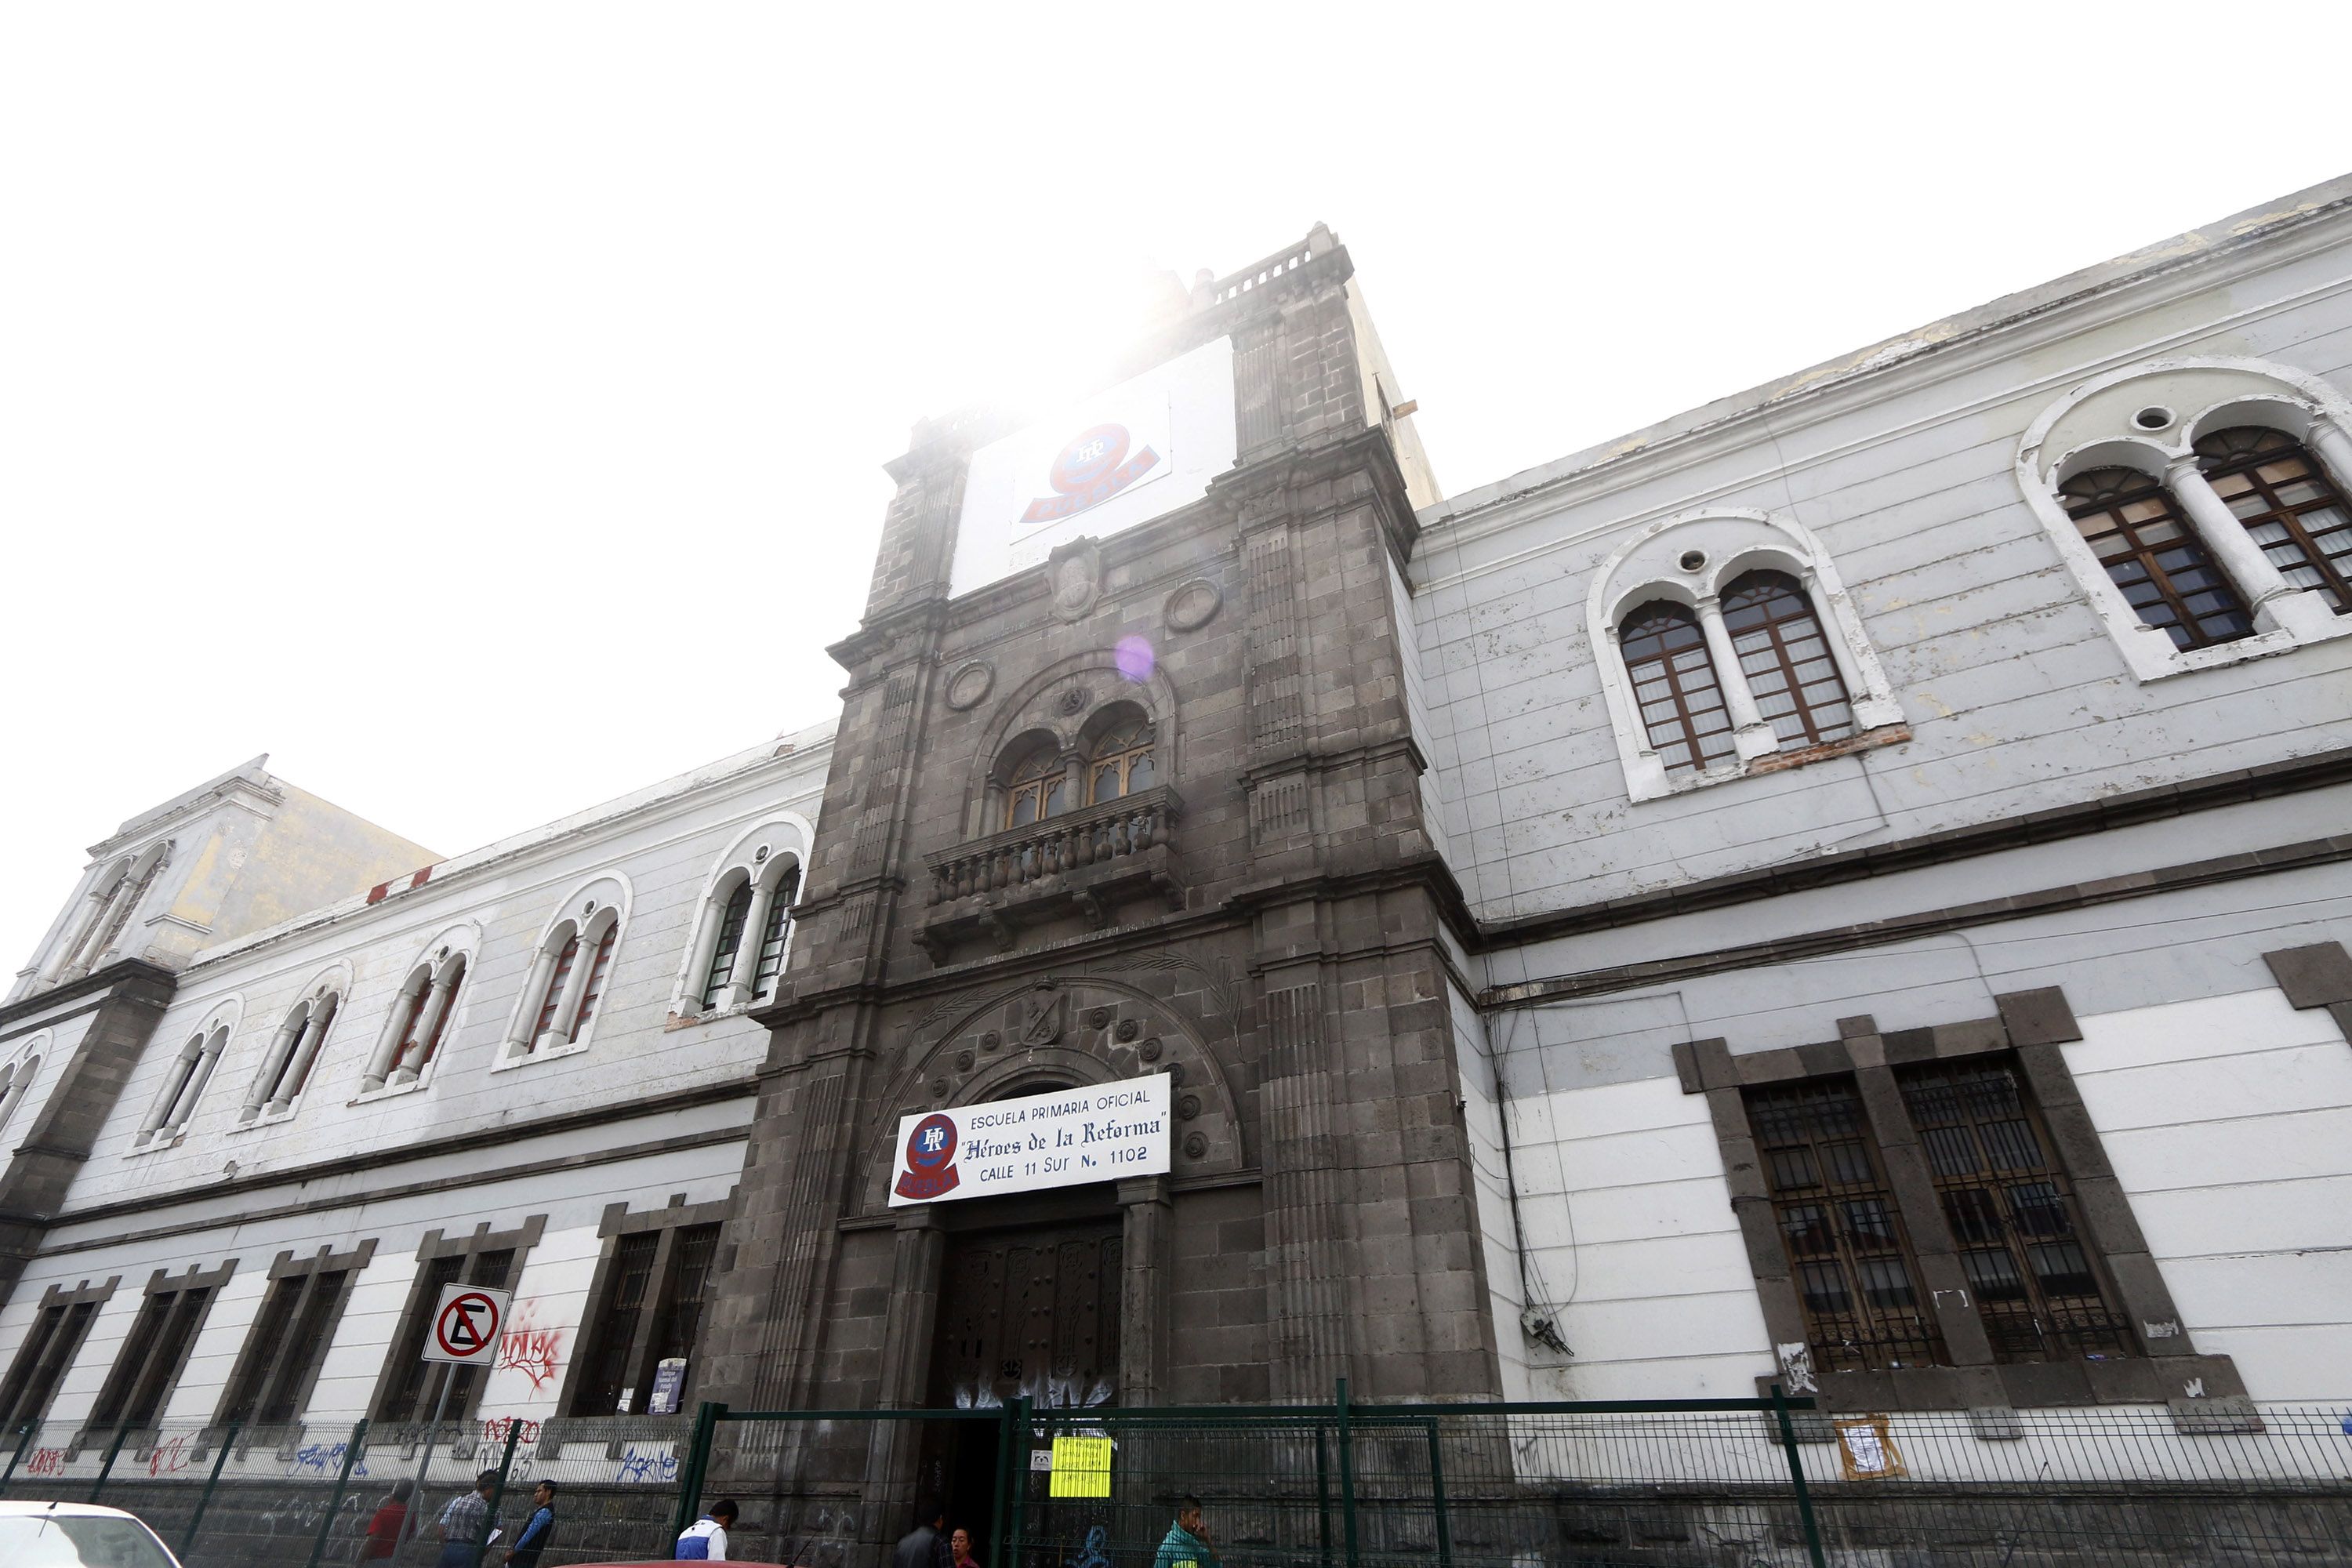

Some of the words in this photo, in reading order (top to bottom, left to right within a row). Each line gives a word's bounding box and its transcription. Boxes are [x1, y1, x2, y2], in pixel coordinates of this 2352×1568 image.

[971, 1110, 1025, 1130] ESCUELA
[1032, 1099, 1089, 1120] PRIMARIA
[1097, 1090, 1150, 1110] OFICIAL
[961, 1138, 1022, 1163] "Héroes
[1029, 1132, 1046, 1151] de
[1055, 1127, 1073, 1148] la
[1081, 1111, 1167, 1148] Reforma"
[980, 1165, 1014, 1182] CALLE
[1025, 1162, 1036, 1176] 11
[1044, 1156, 1070, 1173] Sur
[1110, 1146, 1147, 1164] 1102
